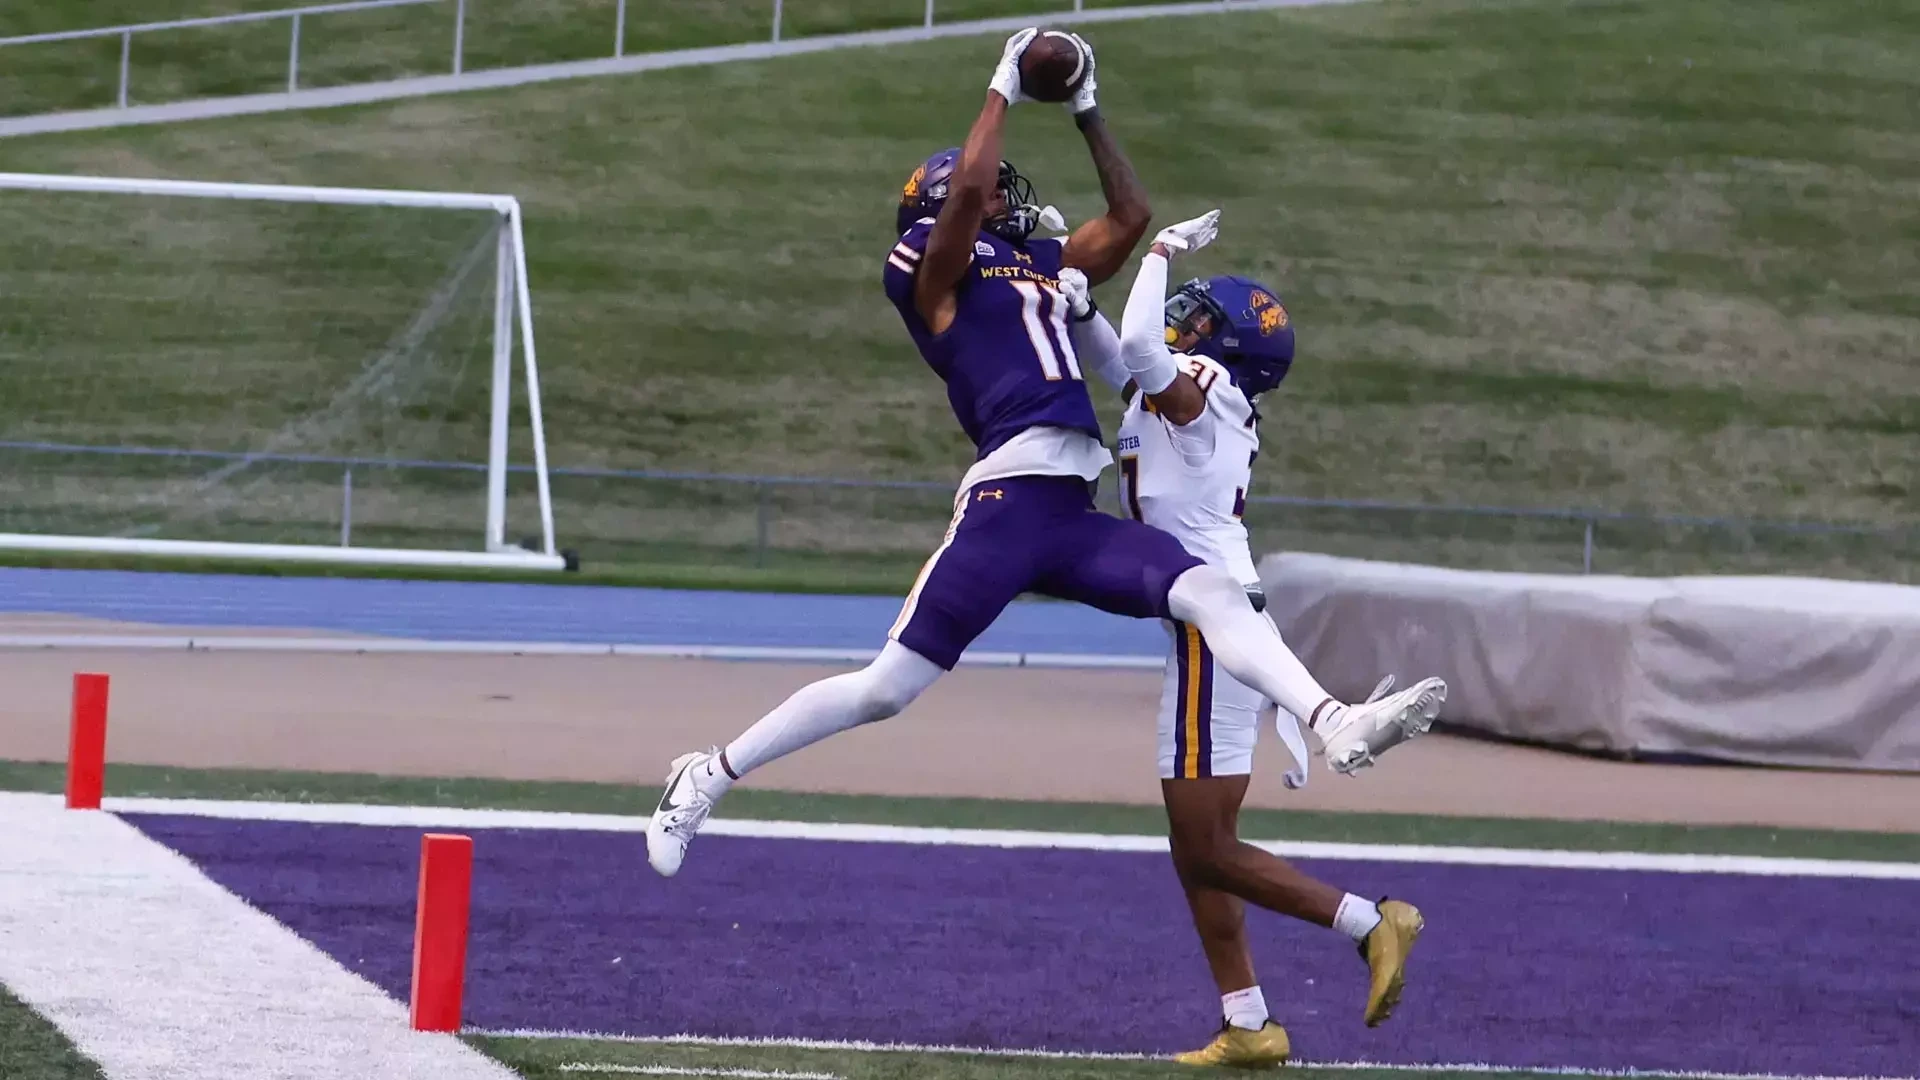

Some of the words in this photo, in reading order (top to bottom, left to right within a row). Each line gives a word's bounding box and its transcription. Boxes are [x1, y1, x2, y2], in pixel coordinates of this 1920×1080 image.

[980, 267, 1020, 278] WEST
[1009, 279, 1083, 381] 11
[1190, 360, 1218, 391] 31
[1119, 436, 1140, 450] STER
